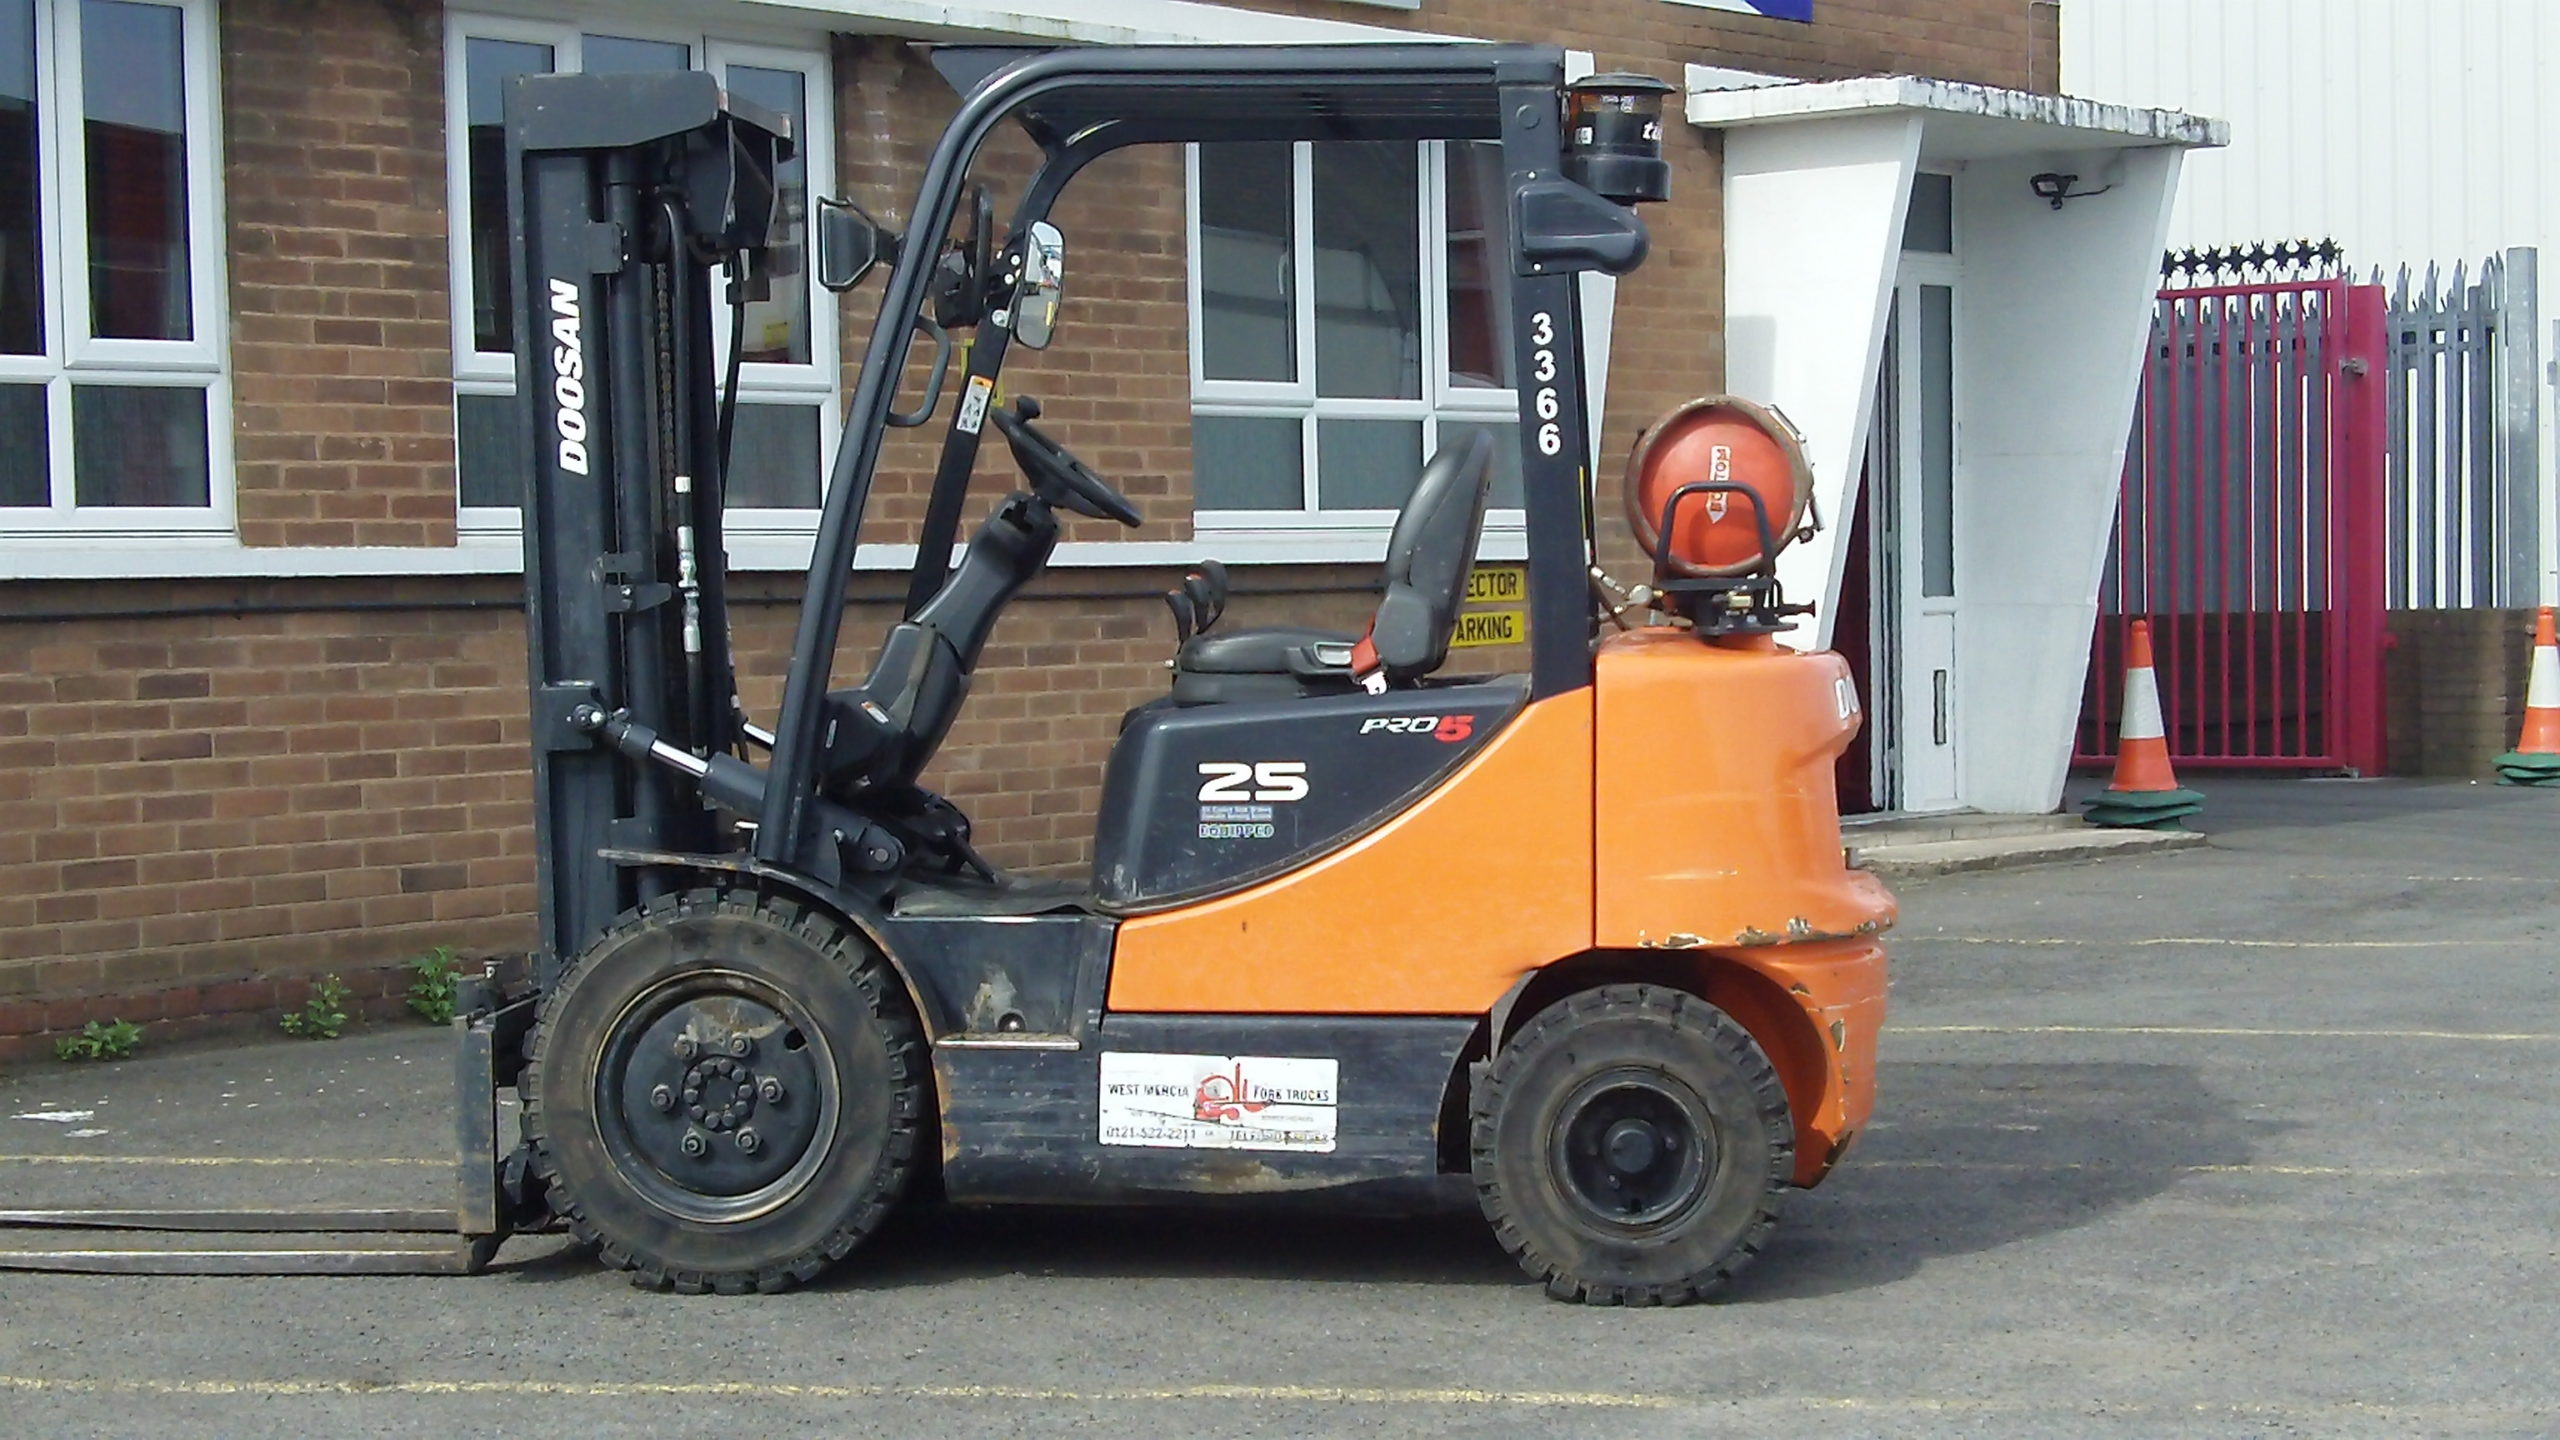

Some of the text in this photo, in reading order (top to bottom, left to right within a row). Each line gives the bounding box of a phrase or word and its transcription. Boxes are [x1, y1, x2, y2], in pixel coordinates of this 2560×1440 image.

[550, 278, 589, 475] DOOSAN
[1532, 312, 1561, 456] 3366
[1198, 762, 1309, 801] 25
[1108, 1083, 1140, 1097] WEST
[1253, 1085, 1283, 1100] FORK
[1287, 1088, 1330, 1102] TRUCKS
